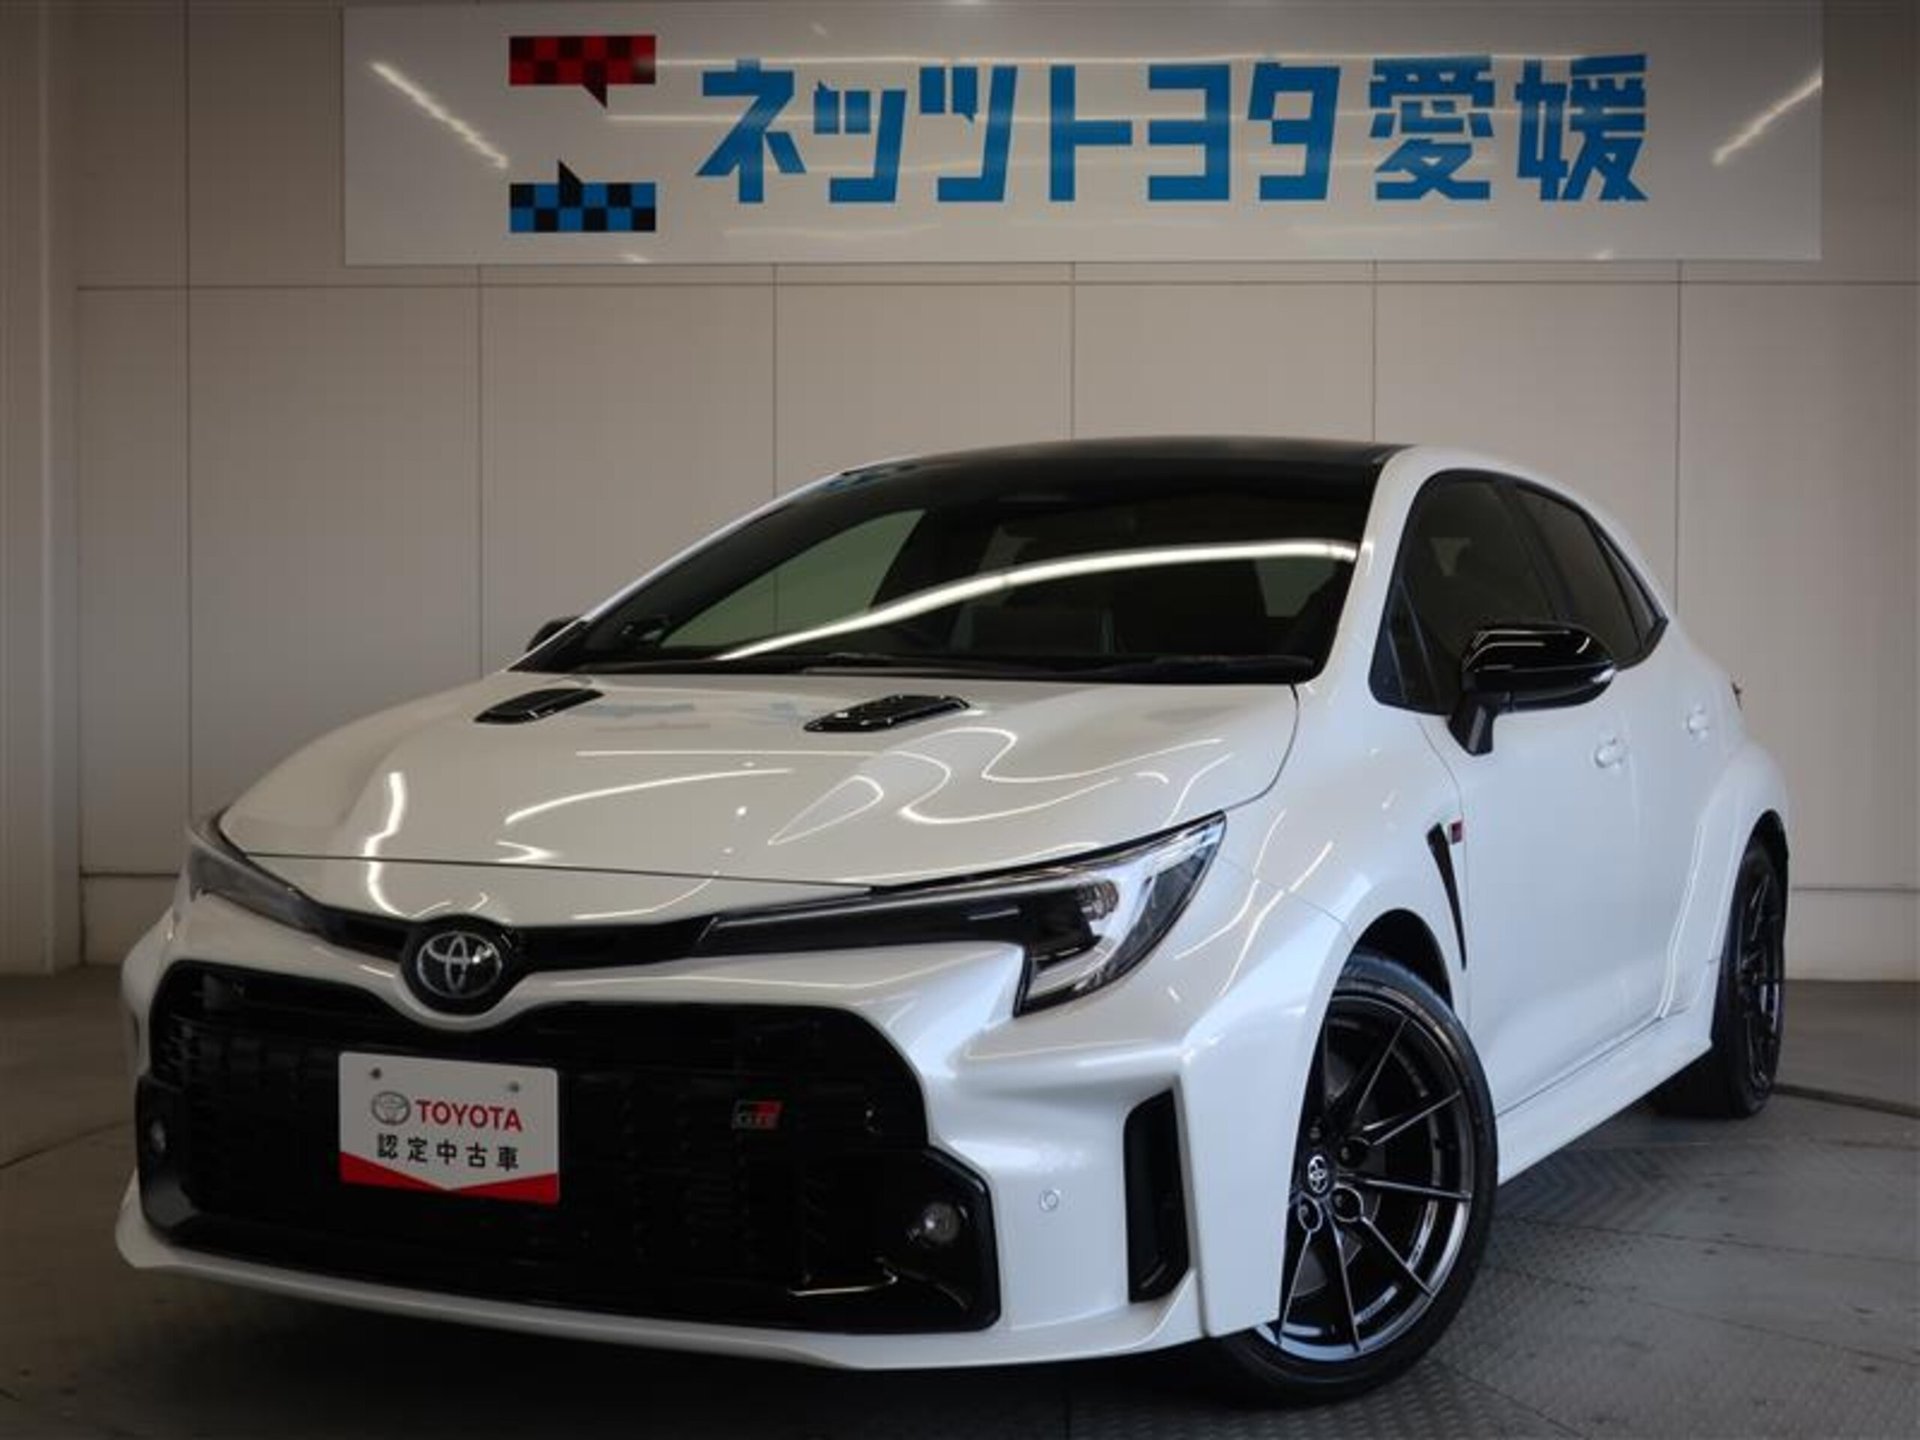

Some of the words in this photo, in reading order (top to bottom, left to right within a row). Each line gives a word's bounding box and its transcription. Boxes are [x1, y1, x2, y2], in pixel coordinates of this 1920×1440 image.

[696, 54, 1648, 203] ネッツトヨタ愛媛
[415, 1100, 522, 1132] TOYOTA
[377, 1134, 519, 1171] 認定中古車
